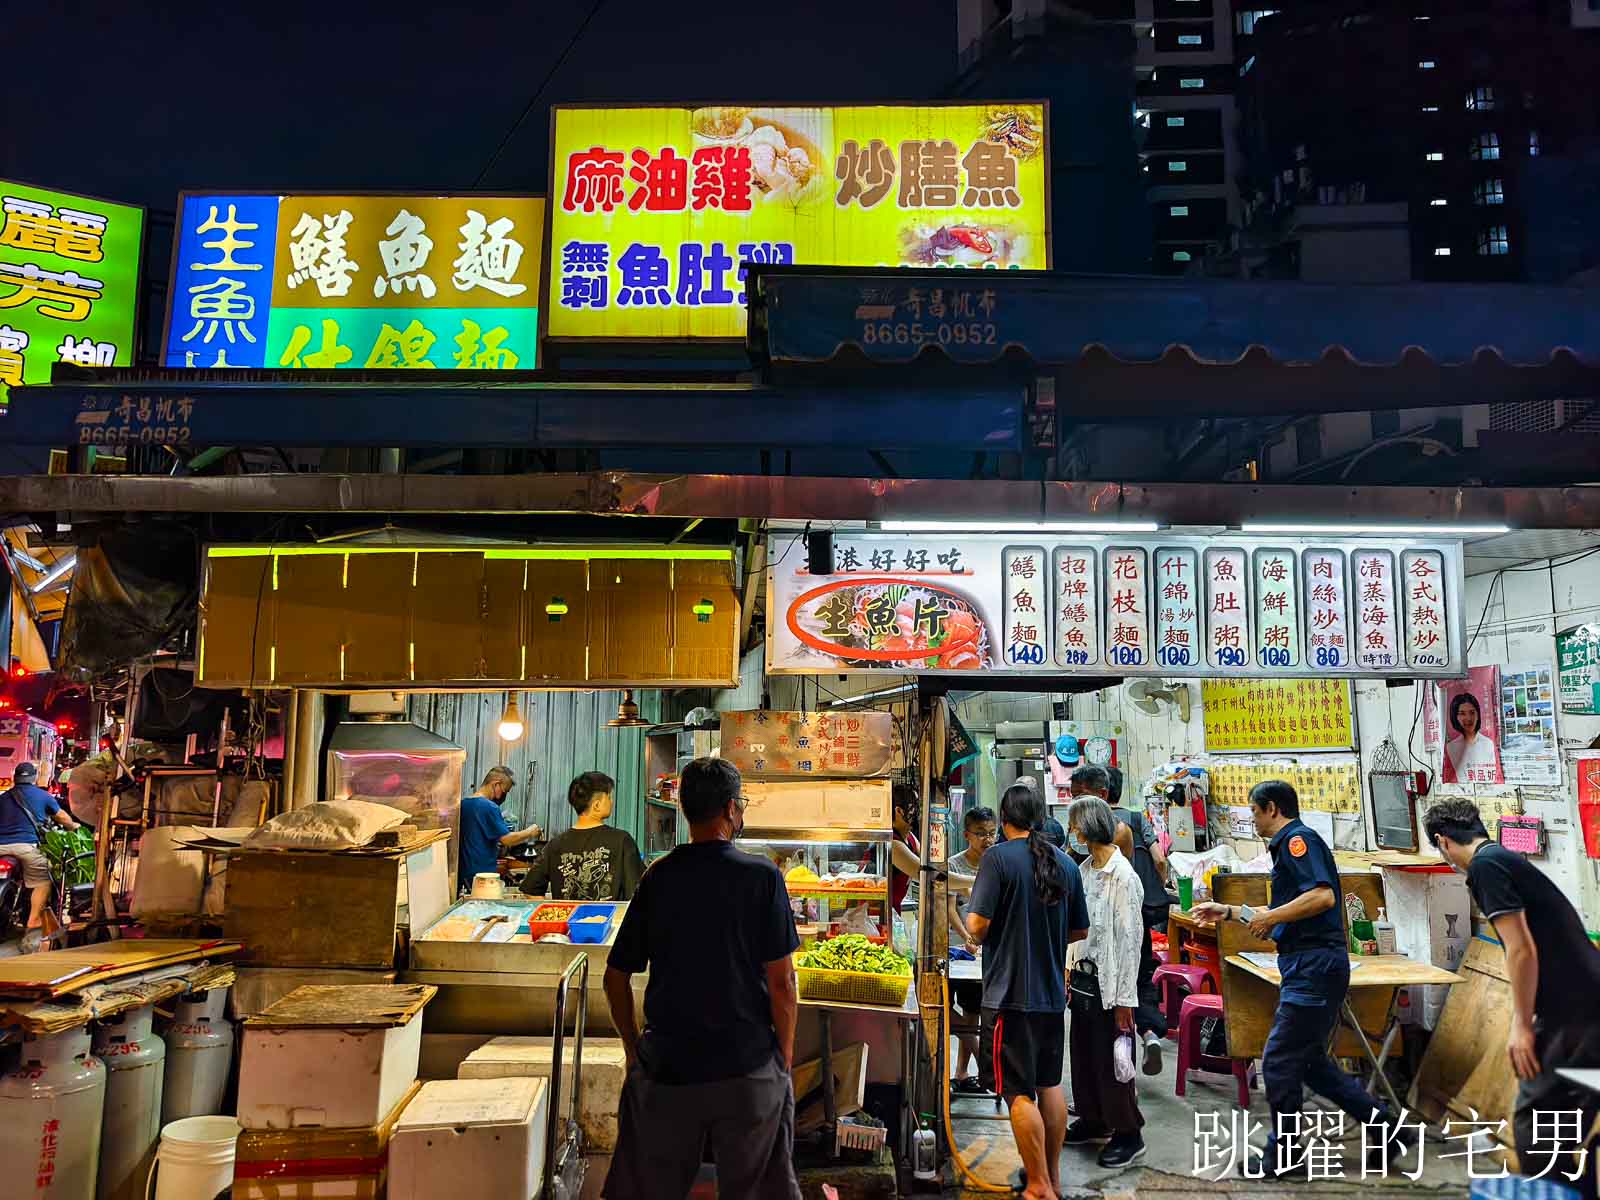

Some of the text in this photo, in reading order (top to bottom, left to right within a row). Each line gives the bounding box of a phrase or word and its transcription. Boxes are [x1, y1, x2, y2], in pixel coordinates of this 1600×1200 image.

[562, 147, 752, 212] 麻油雞
[836, 140, 1020, 208] 炒膳魚
[182, 205, 263, 368] 生魚
[287, 209, 526, 298] 鱔魚麵
[562, 240, 609, 309] 無刺
[863, 322, 998, 346] 8665-0952
[80, 426, 191, 444] 8665-0952
[804, 548, 965, 573] 港好好吃
[814, 596, 949, 638] 生魚片
[1008, 556, 1043, 664] 鱔魚麵 140
[1061, 556, 1089, 647] 招牌鱔魚
[1110, 556, 1142, 665] 花枝麵 100
[1212, 557, 1240, 646] 魚肚粥
[1259, 557, 1291, 666] 海鮮粥 100
[1361, 558, 1392, 665] 清蒸海魚 時價
[1409, 558, 1440, 649] 各式熱炒
[1158, 647, 1190, 665] 100
[1316, 647, 1340, 666] 80
